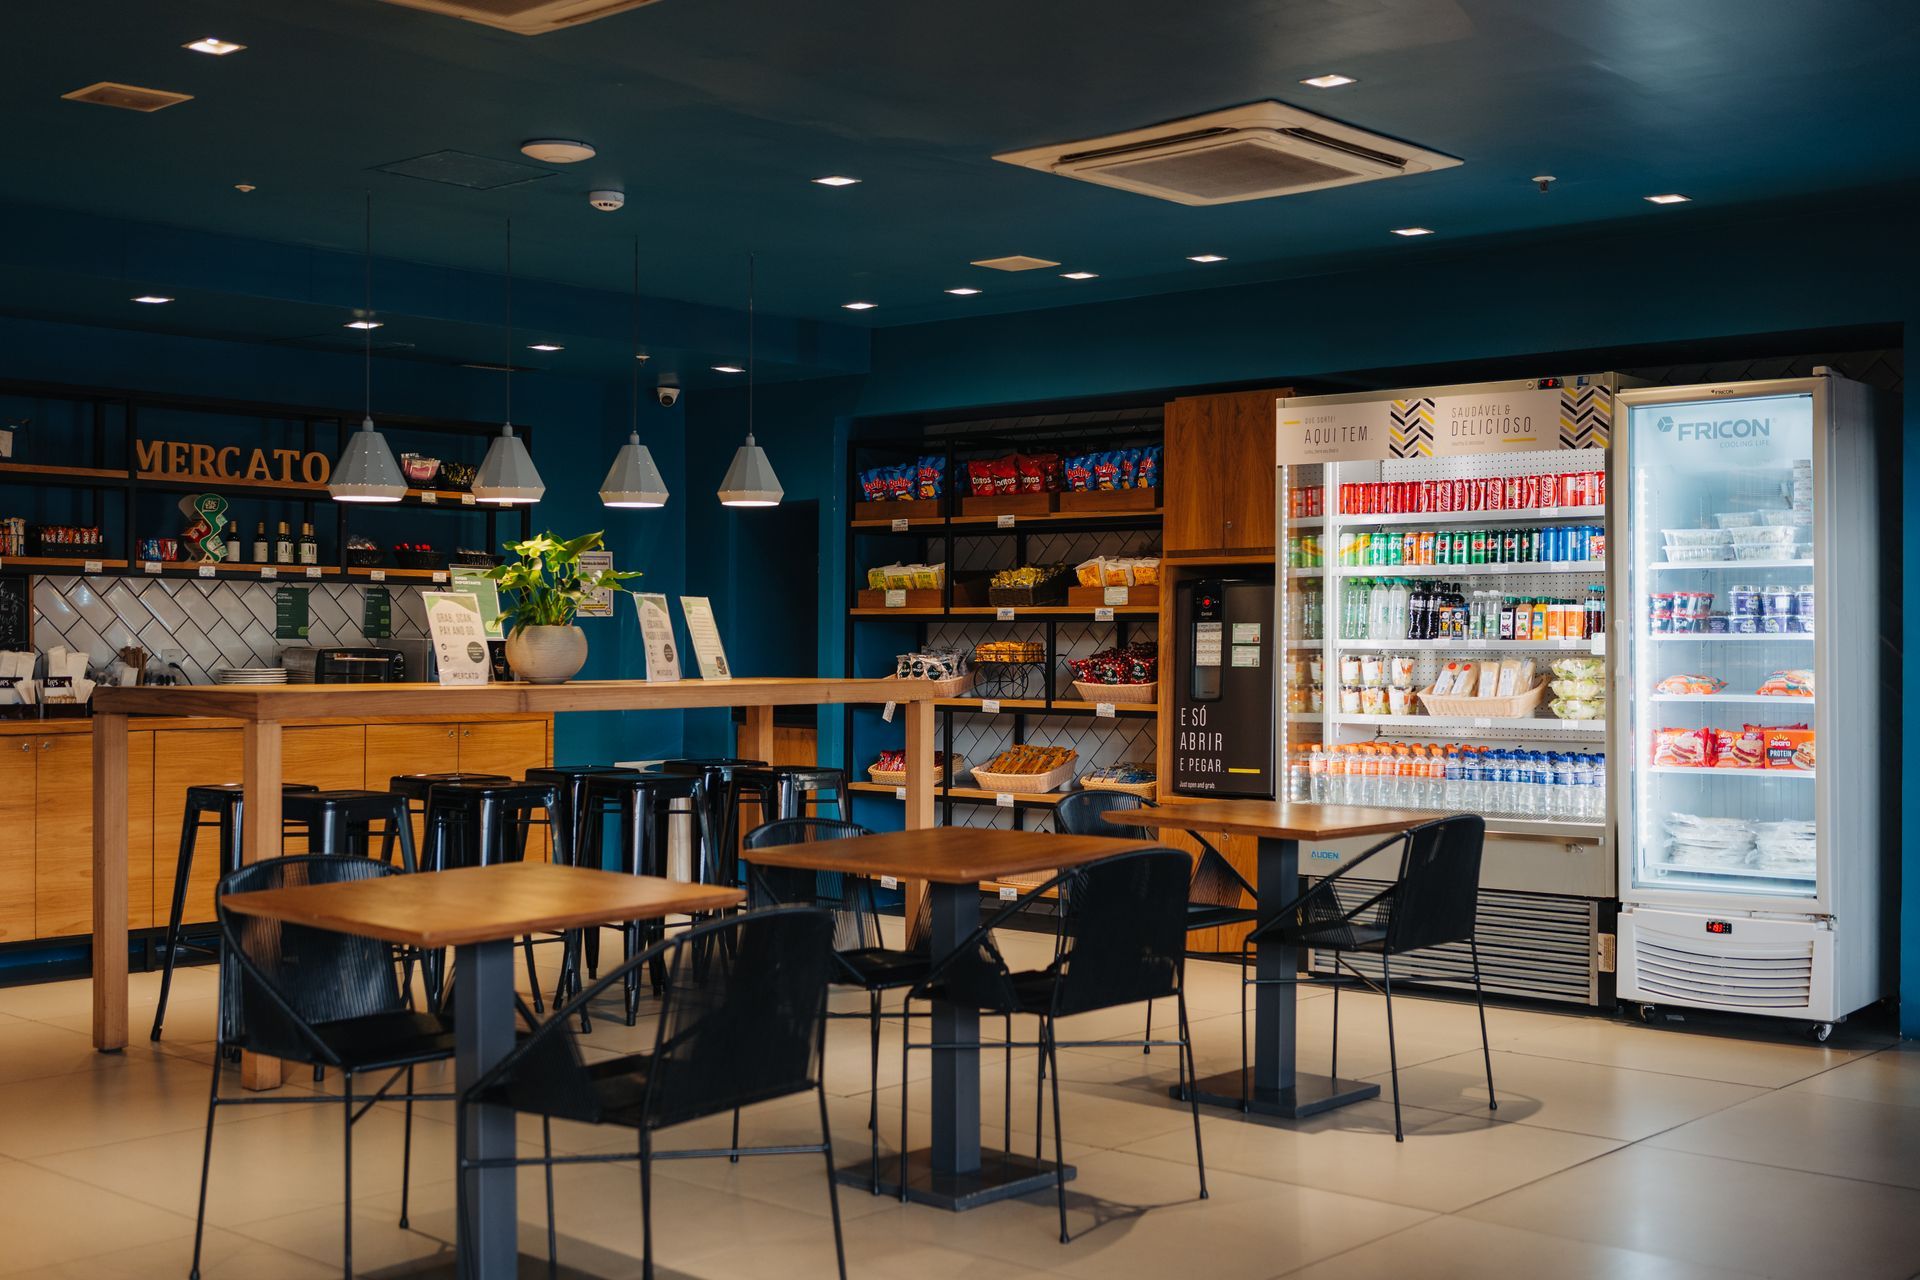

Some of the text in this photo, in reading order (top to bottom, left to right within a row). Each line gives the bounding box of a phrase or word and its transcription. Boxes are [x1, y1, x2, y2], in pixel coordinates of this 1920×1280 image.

[1451, 404, 1511, 418] SAUDÁVEL &
[1304, 428, 1336, 445] AQUI
[1451, 416, 1537, 437] DELICIOSO.
[1678, 418, 1770, 441] FRICON
[1720, 441, 1753, 449] COOLING
[136, 439, 331, 485] MERCATO
[1192, 704, 1207, 727] SÓ
[1180, 731, 1223, 752] ABRIR
[1180, 757, 1226, 773] E PEGAR.
